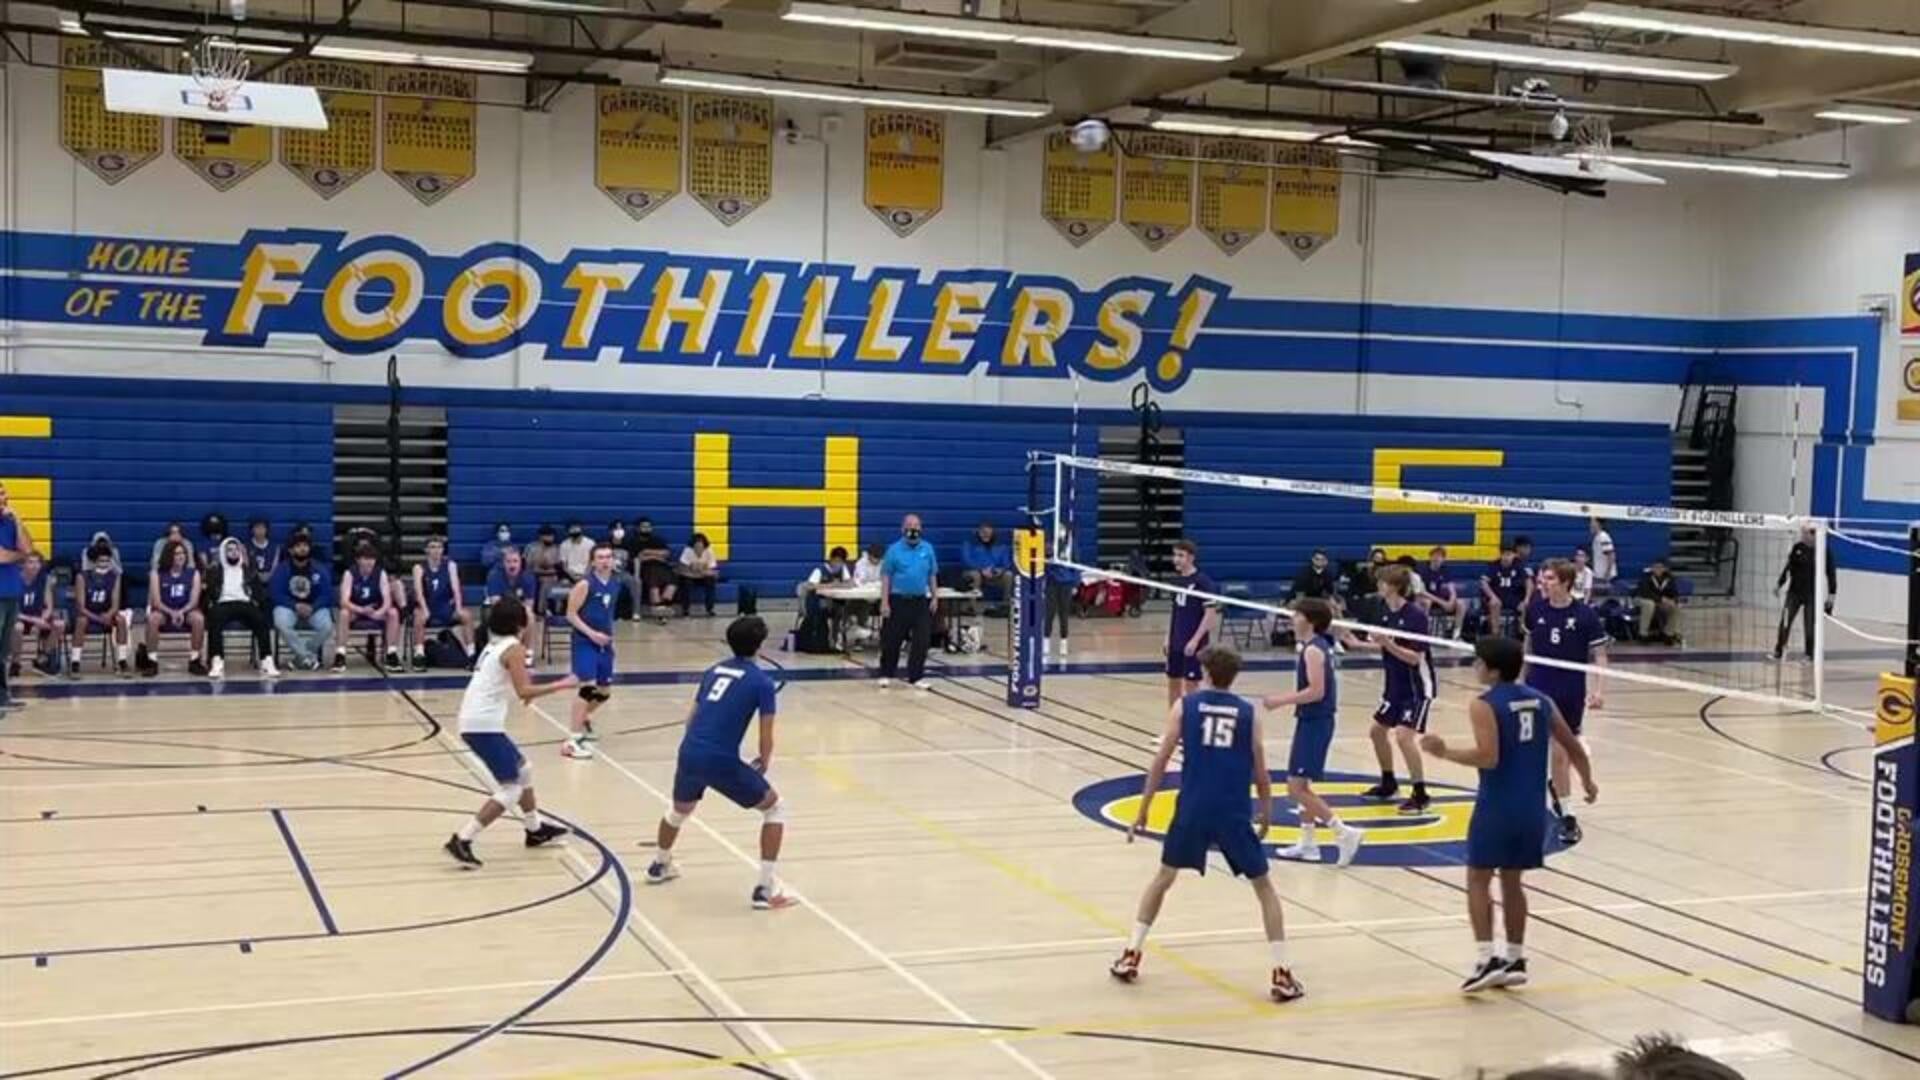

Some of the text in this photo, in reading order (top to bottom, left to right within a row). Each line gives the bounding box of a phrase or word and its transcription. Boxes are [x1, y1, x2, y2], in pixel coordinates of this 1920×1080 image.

[88, 242, 194, 274] HOME
[65, 287, 206, 321] OF THE
[223, 243, 1218, 380] FOOTHILLERS!
[694, 433, 859, 560] H
[1372, 448, 1504, 561] S
[1550, 627, 1561, 644] 6
[1201, 715, 1237, 748] 15
[1518, 711, 1535, 742] 8
[1864, 759, 1898, 988] FOOTHILLERS
